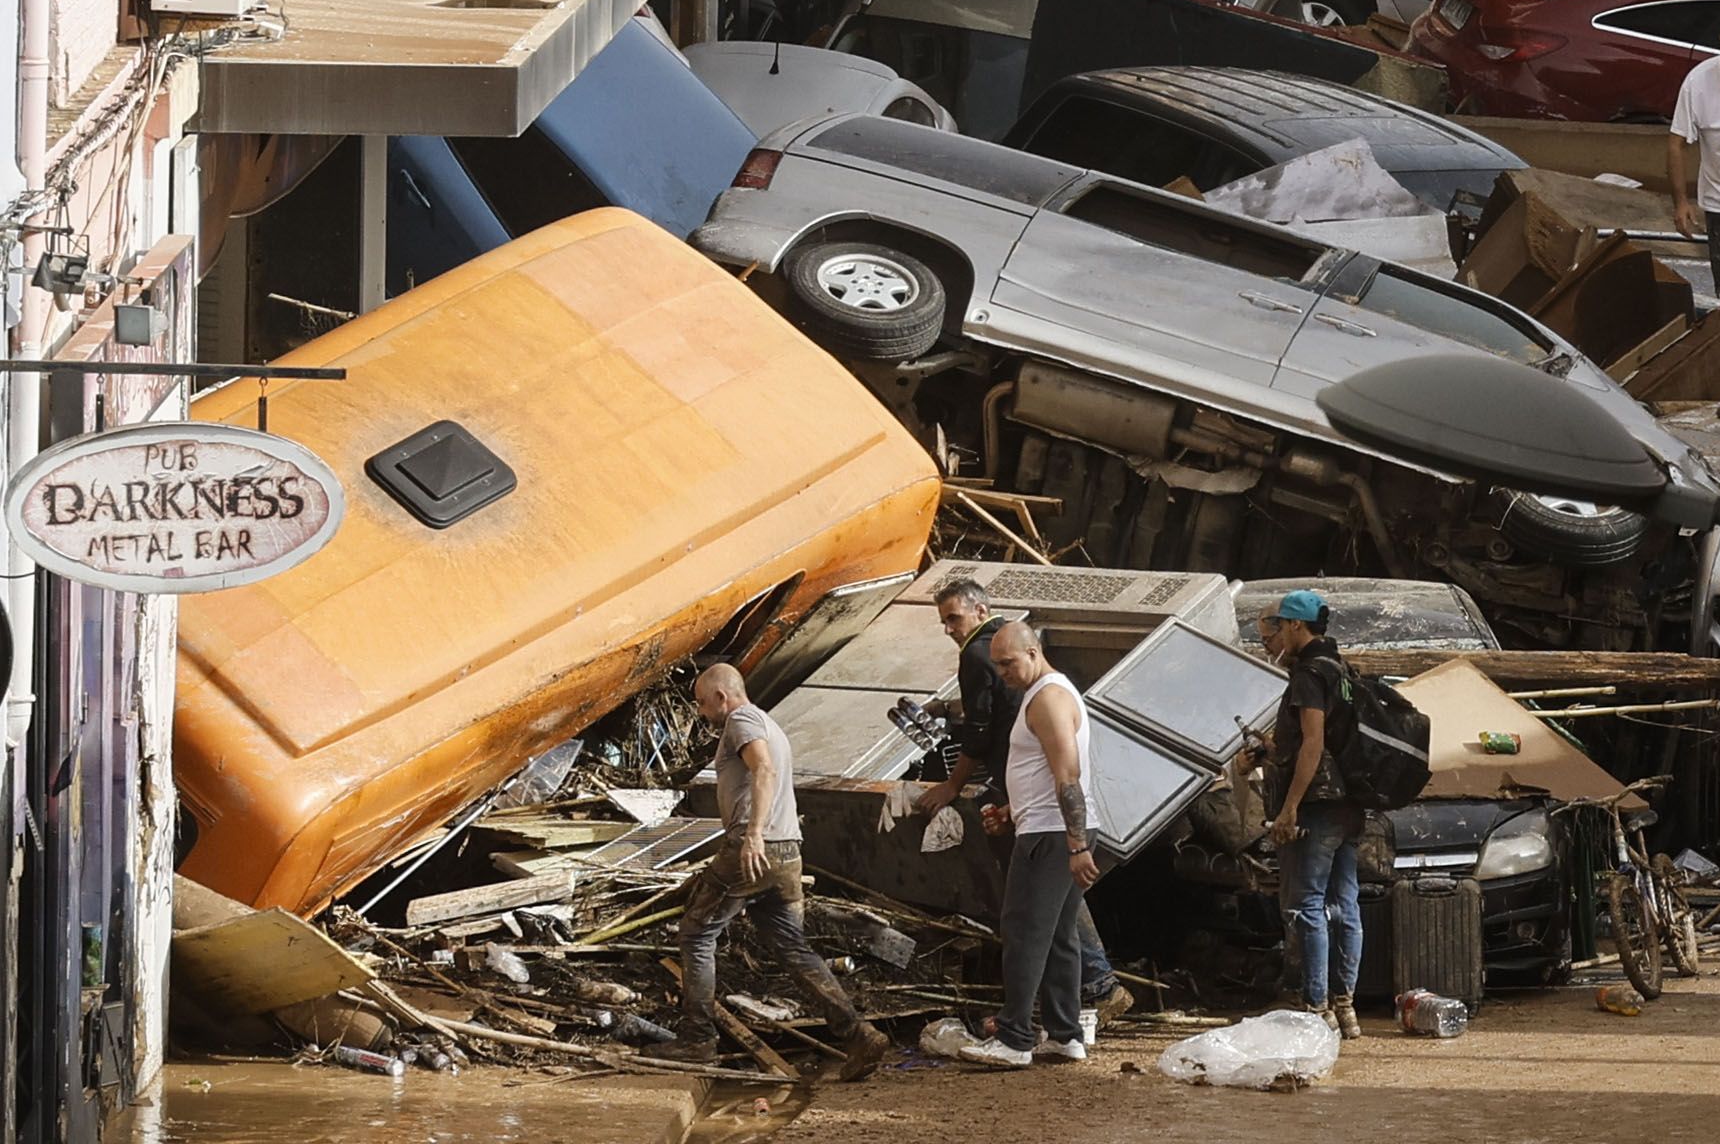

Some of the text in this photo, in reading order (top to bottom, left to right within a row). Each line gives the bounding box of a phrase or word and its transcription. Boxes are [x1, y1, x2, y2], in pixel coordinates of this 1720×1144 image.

[144, 443, 199, 474] PUB
[44, 476, 305, 525] DARKNESS
[87, 529, 256, 562] METAL BAR
